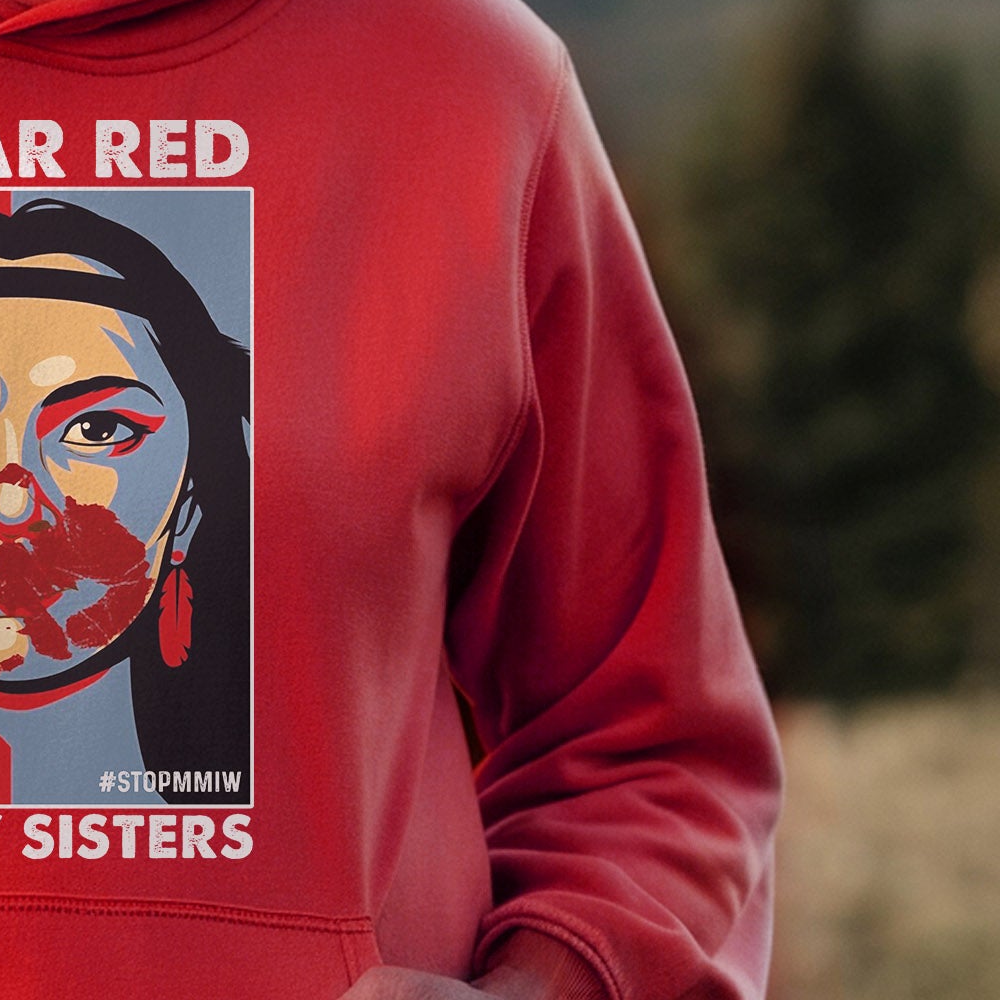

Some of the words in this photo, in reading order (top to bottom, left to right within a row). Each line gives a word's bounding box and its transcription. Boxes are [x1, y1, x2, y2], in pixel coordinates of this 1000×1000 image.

[95, 119, 250, 179] RED
[98, 770, 242, 793] #STOPMMIW
[21, 813, 254, 860] SISTERS
